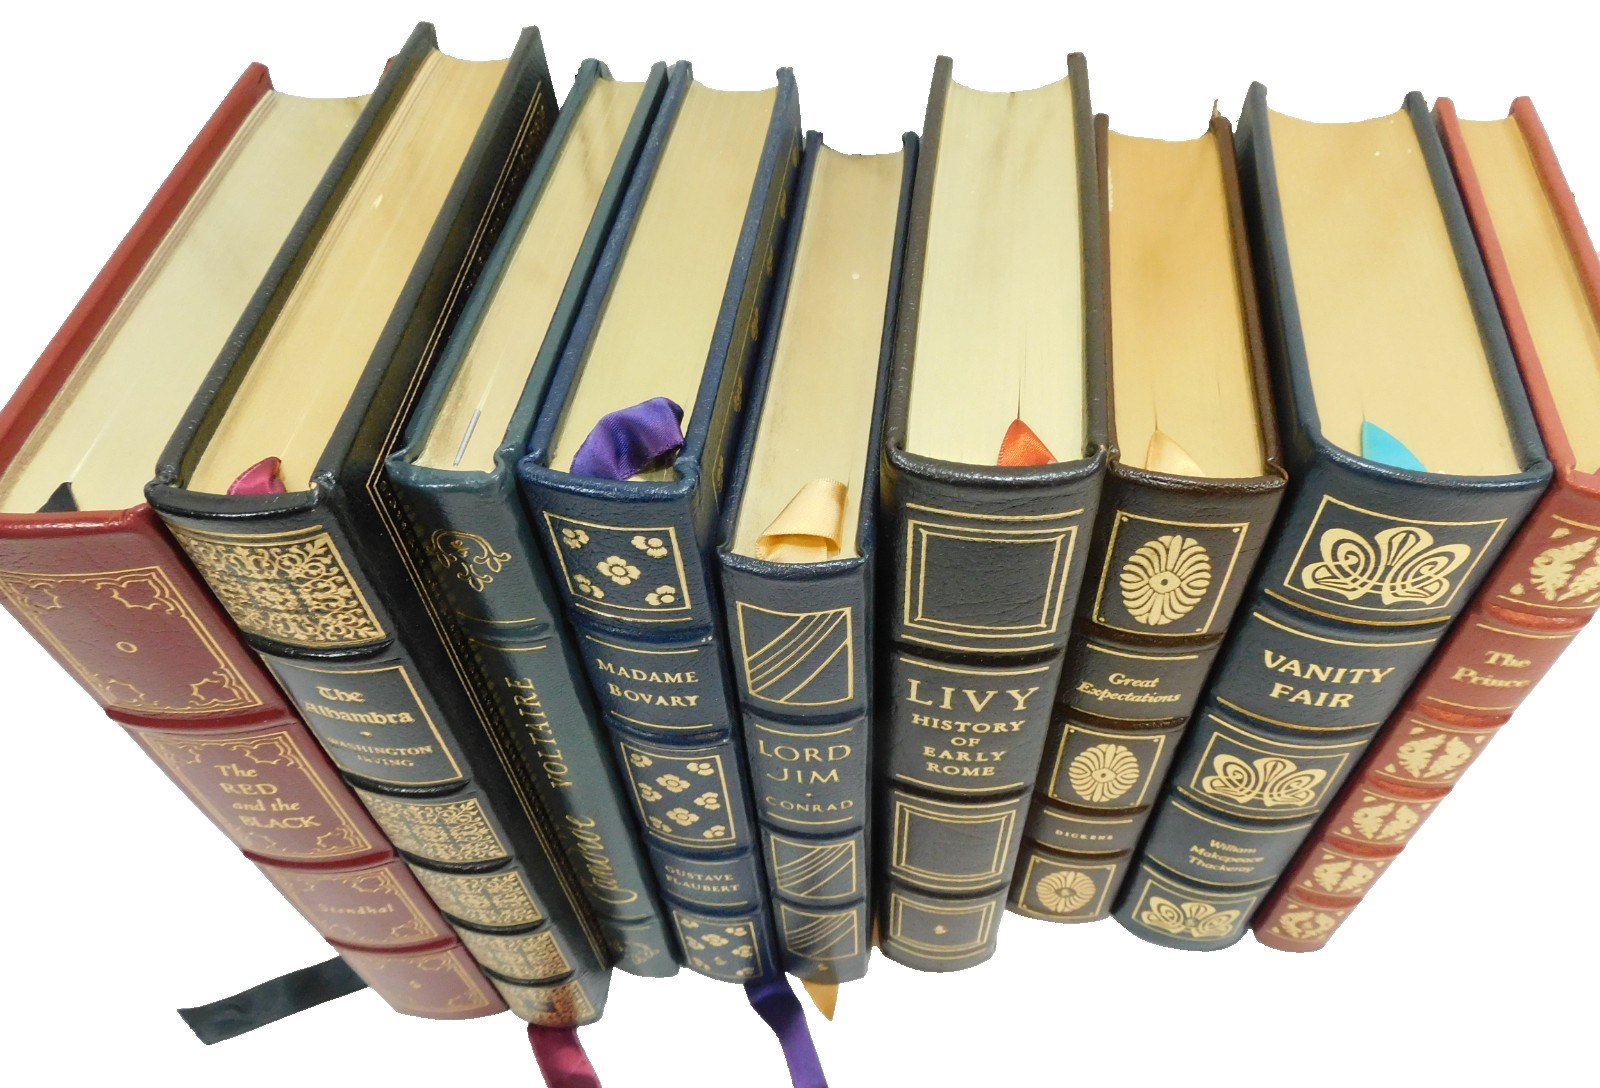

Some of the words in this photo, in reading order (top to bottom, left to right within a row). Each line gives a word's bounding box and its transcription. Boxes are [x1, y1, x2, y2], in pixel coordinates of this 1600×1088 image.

[1264, 650, 1396, 684] VANITY
[1483, 650, 1532, 668] The
[596, 658, 699, 684] MADAME
[1450, 667, 1531, 688] Prince
[1108, 673, 1160, 688] Great
[316, 686, 366, 704] The
[607, 682, 699, 707] BOVARY
[906, 678, 1040, 713] LIVY
[1076, 681, 1182, 703] Expectations
[1269, 682, 1355, 708] FAIR
[304, 701, 416, 725] Alhambra
[504, 676, 574, 789] VOLTAIRE
[911, 713, 1026, 734] HISTORY
[327, 737, 433, 756] WASHINGTON
[758, 739, 852, 763] LORD
[950, 737, 981, 747] OF
[922, 746, 1008, 762] EARLY
[214, 763, 258, 777] The
[767, 768, 839, 784] JIM
[926, 761, 996, 777] ROME
[219, 783, 278, 796] RED
[232, 799, 266, 811] and
[271, 798, 300, 811] the
[765, 796, 854, 813] CONRAD
[239, 815, 321, 829] BLACK
[1055, 829, 1113, 841] DICKENS
[1189, 845, 1265, 864] Makepeace
[1209, 839, 1257, 854] William
[565, 814, 639, 905] Candide
[1188, 855, 1256, 873] Thackeray
[664, 864, 734, 881] GUSTAVE
[665, 873, 740, 893] FLAUBERT
